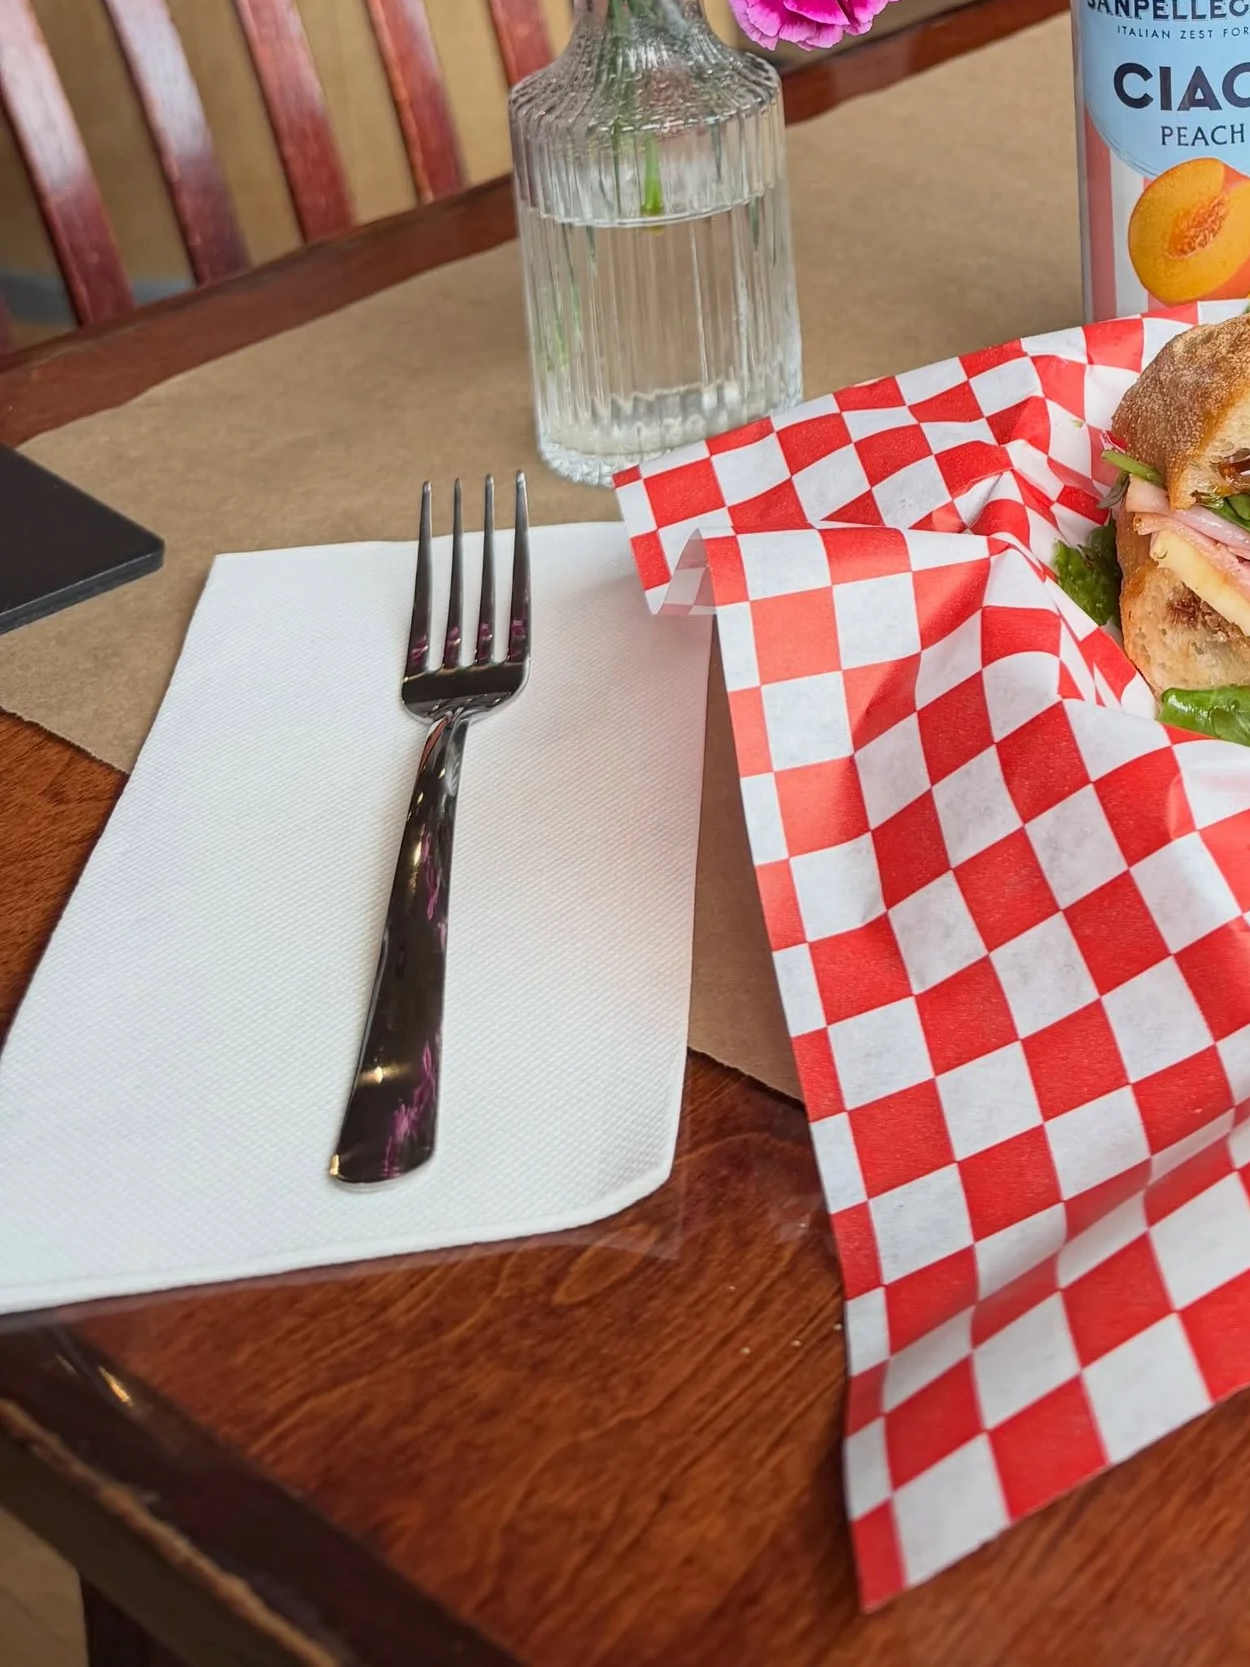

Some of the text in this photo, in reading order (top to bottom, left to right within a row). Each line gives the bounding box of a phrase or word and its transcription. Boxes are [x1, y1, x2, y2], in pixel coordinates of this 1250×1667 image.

[1117, 25, 1171, 39] ITALIAN
[1180, 29, 1213, 40] ZEST
[1223, 26, 1250, 37] FOR
[1160, 123, 1246, 147] PEACH
